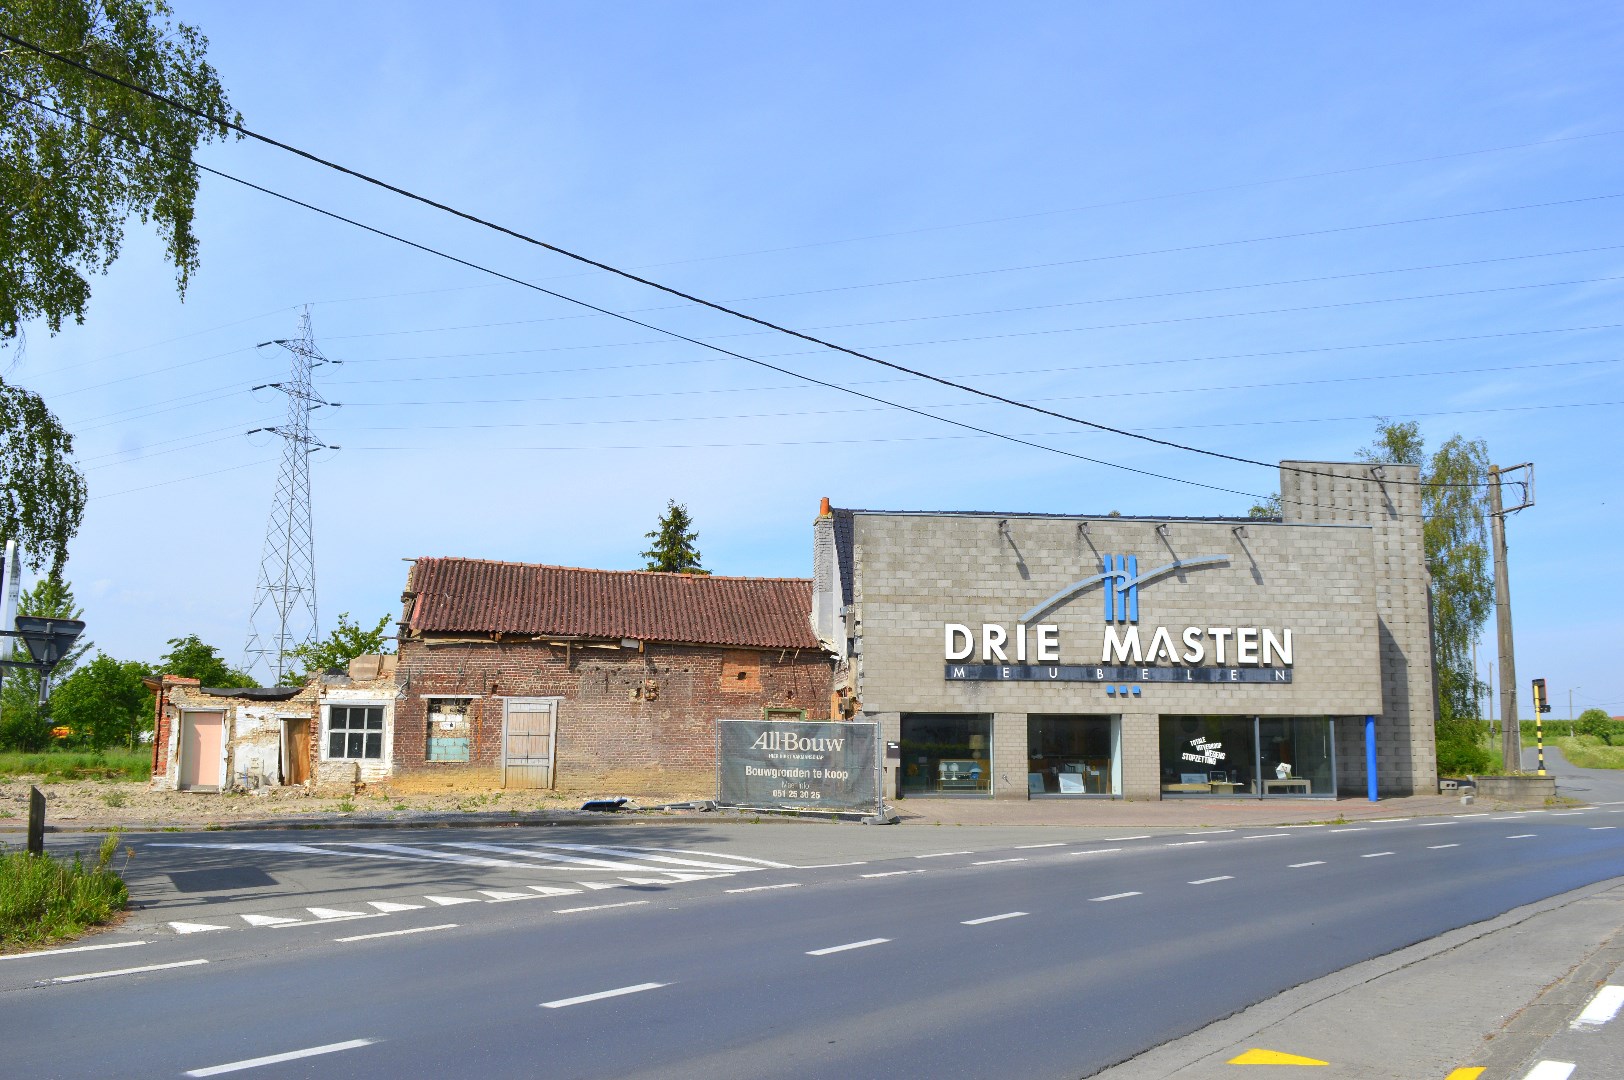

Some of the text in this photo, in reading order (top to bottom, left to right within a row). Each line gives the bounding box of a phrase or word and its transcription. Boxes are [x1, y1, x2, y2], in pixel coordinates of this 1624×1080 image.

[945, 624, 1293, 665] DRIE MASTEN
[953, 666, 1286, 681] MEUBELEN
[1182, 753, 1216, 765] STOPZETTING
[1205, 750, 1225, 759] WEGENS
[745, 766, 848, 781] Bouwgronden te koop
[799, 791, 808, 799] 30
